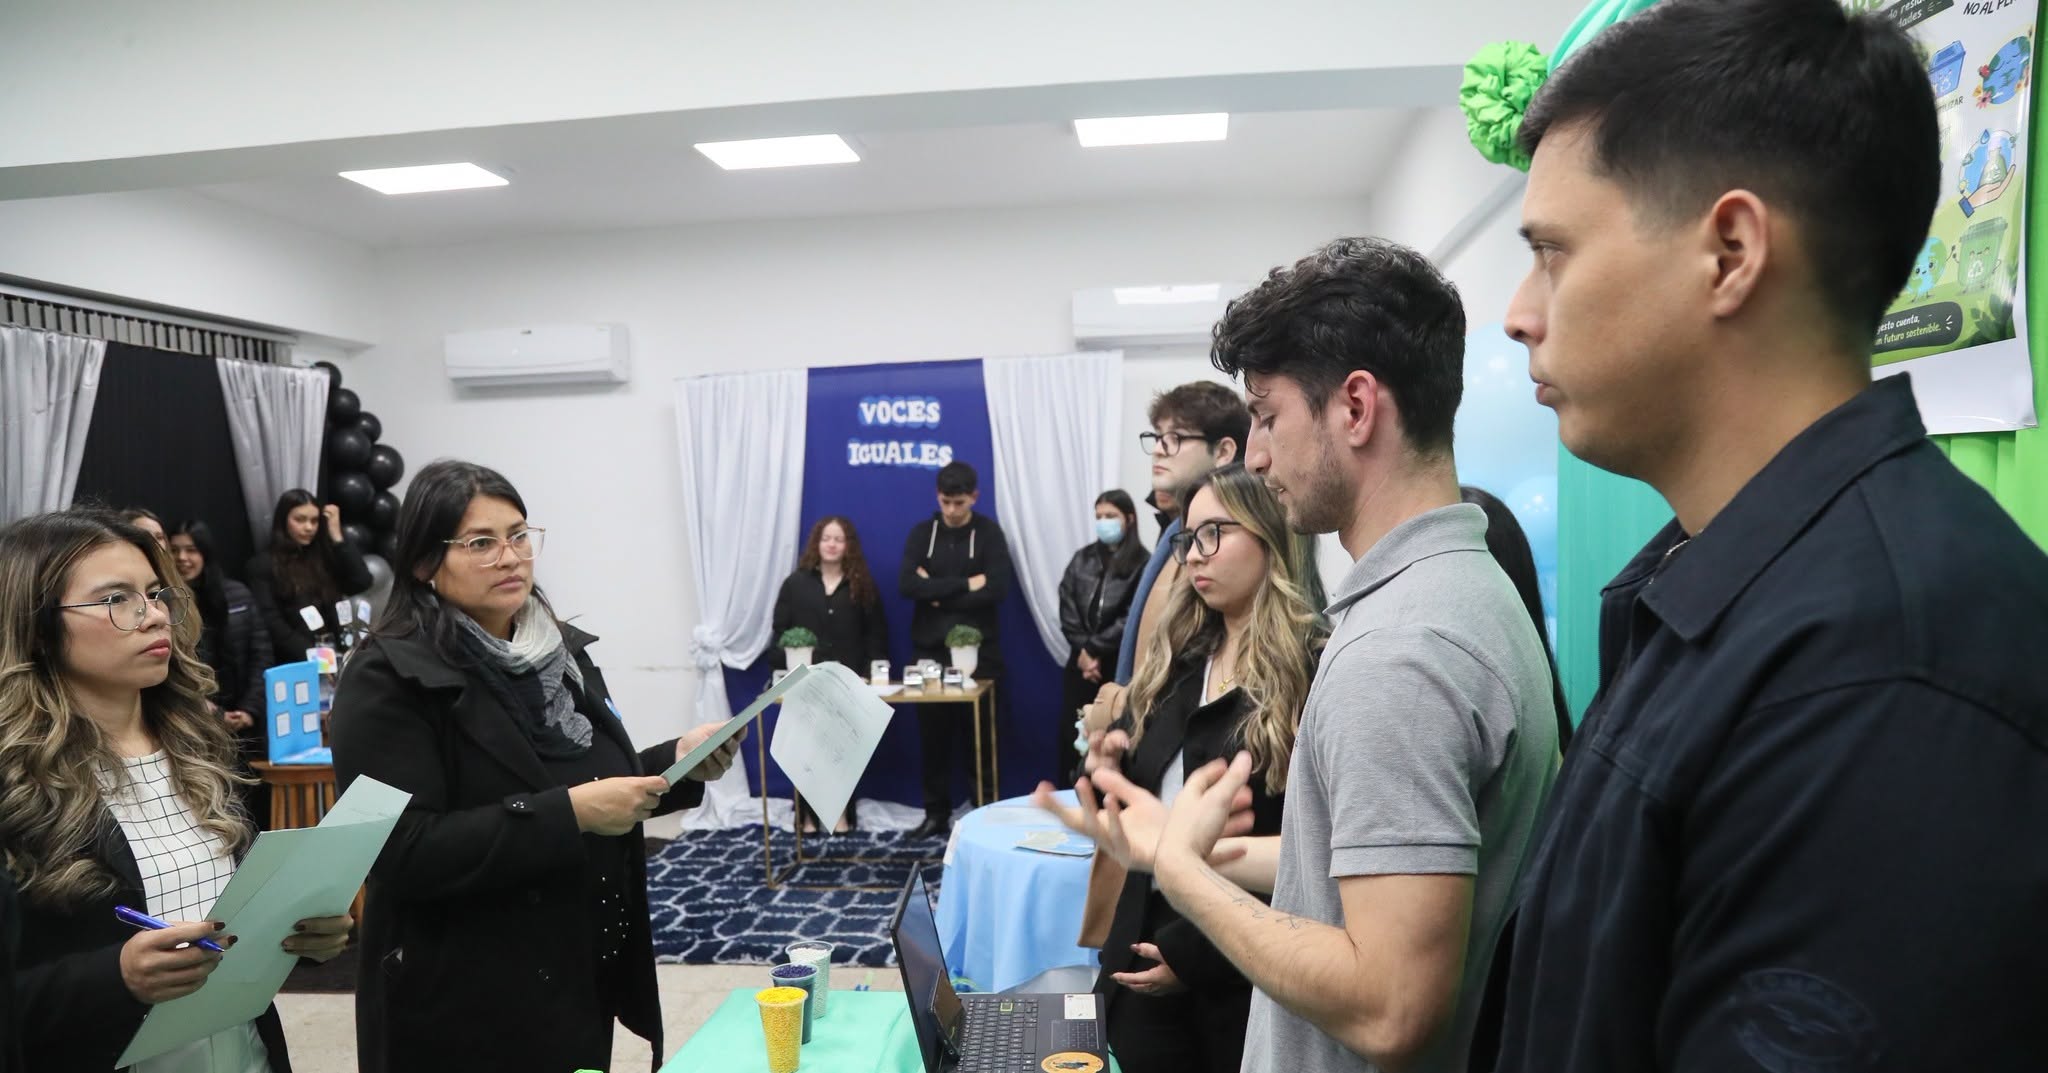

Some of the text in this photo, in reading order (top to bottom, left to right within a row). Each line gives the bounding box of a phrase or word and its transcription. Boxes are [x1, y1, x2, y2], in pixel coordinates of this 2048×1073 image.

[1963, 2, 1980, 15] NO
[1979, 1, 1994, 15] AL
[1896, 314, 1920, 328] cuenta,
[1884, 332, 1904, 344] futuro
[859, 399, 941, 425] VOCES
[848, 441, 953, 468] IGUALES
